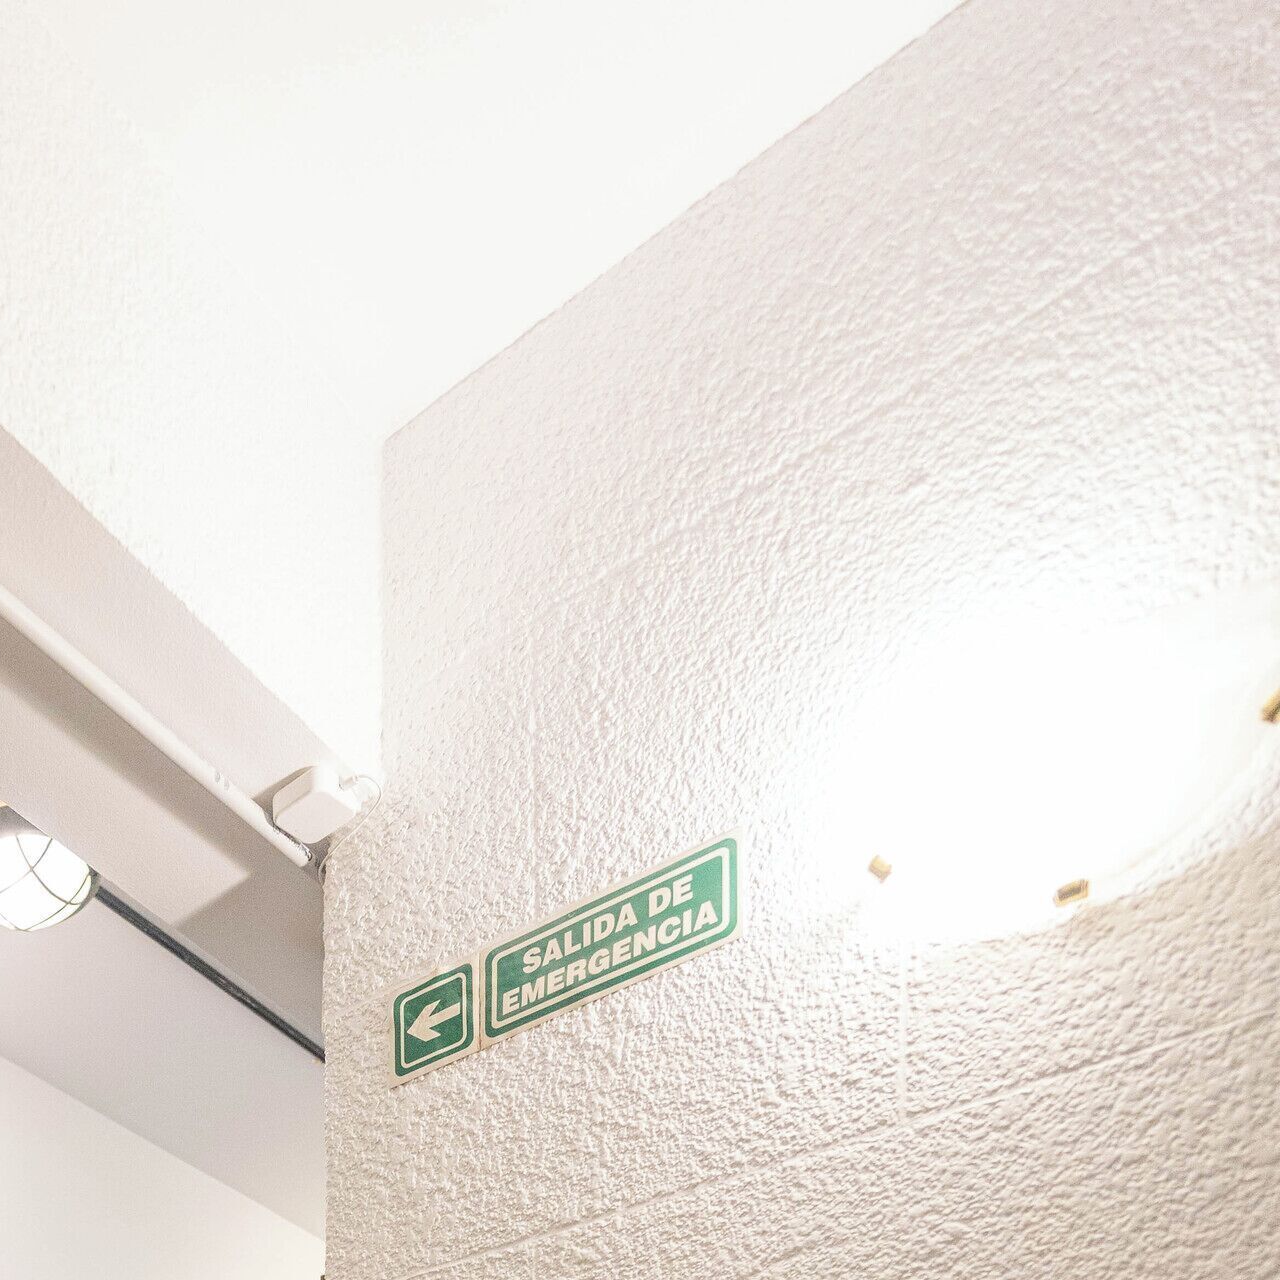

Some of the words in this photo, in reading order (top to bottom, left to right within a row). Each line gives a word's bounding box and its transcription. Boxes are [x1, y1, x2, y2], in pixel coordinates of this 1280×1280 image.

[502, 900, 718, 1016] EMERGENCIA
[522, 902, 638, 974] SALIDA
[648, 874, 694, 918] DE
